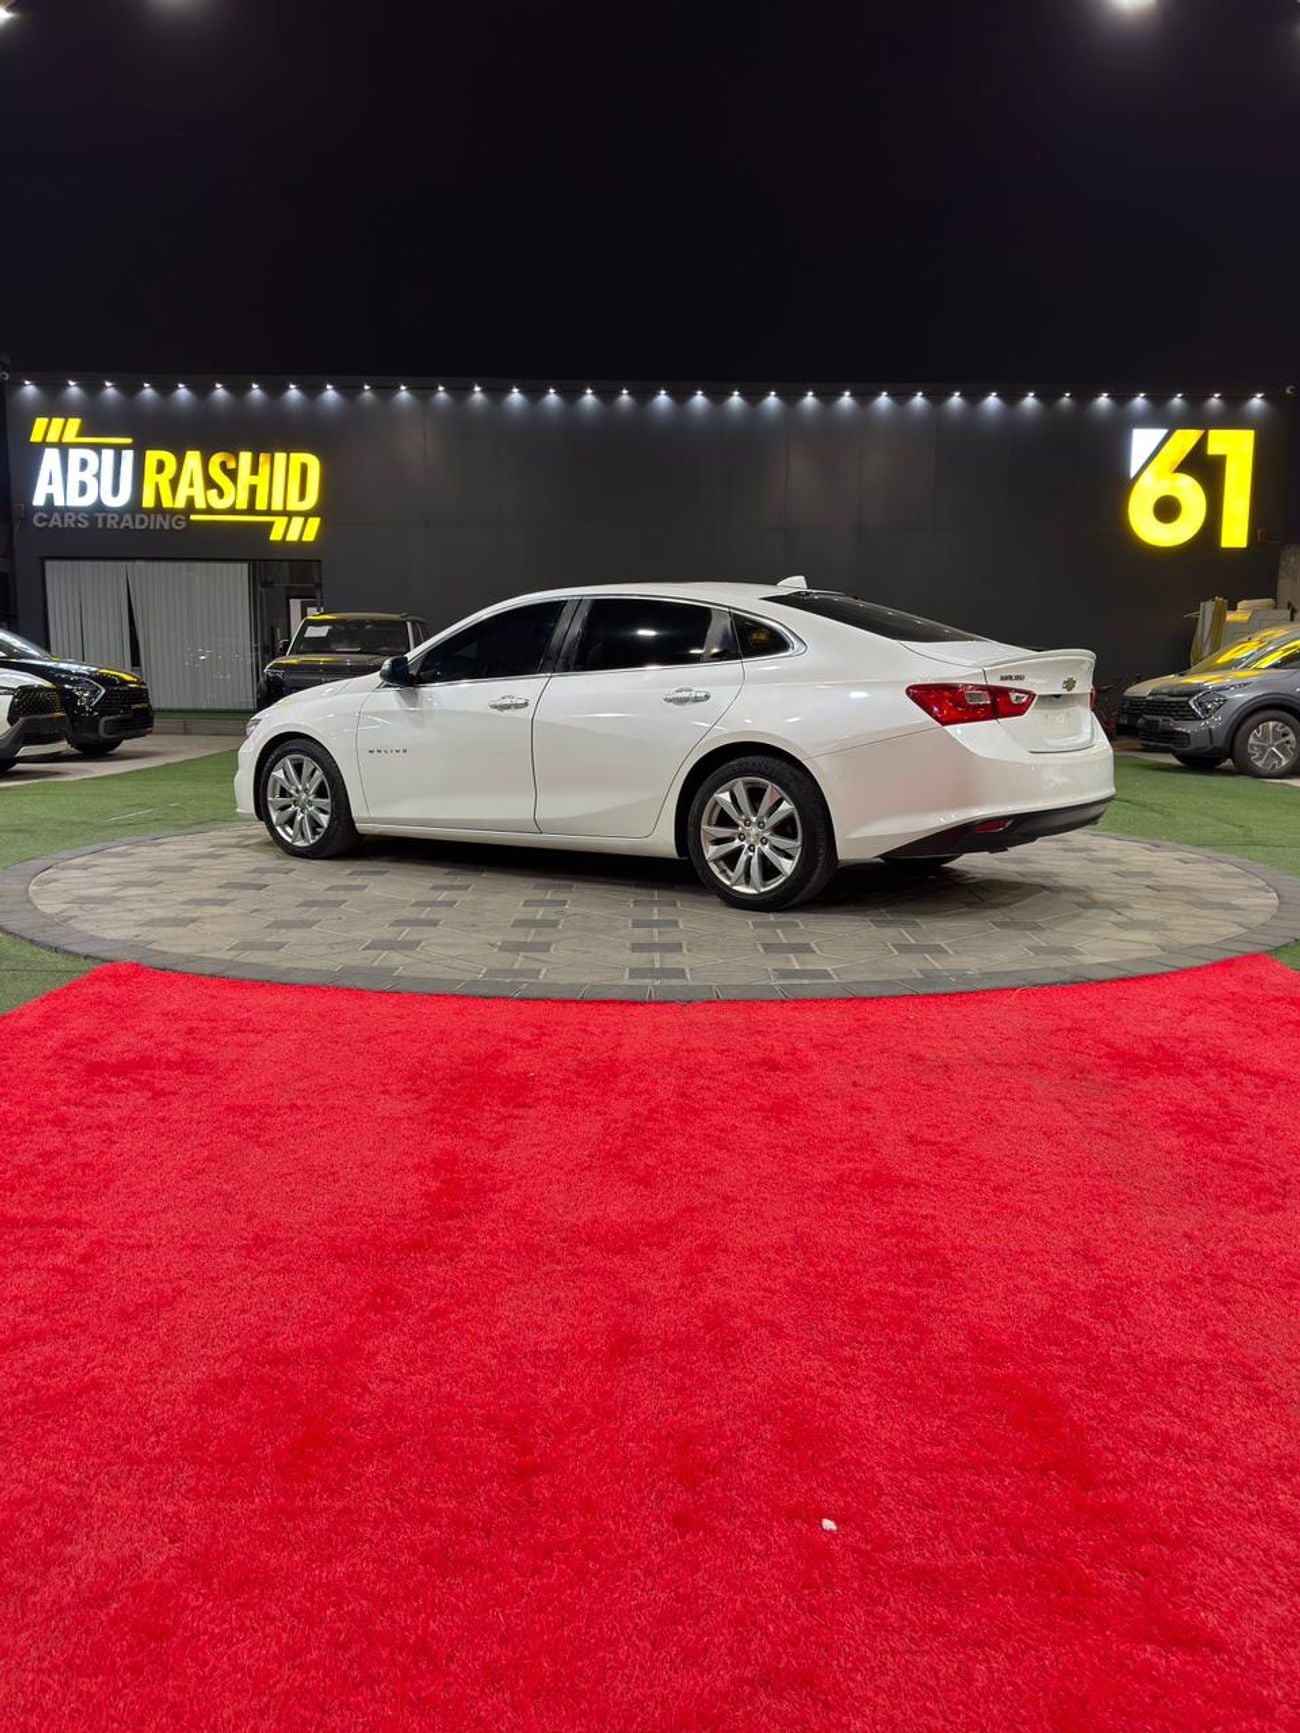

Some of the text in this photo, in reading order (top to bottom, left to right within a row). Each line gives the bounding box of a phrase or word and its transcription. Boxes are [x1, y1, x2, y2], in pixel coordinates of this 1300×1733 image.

[32, 448, 321, 511] ABU RASHID
[1128, 428, 1255, 548] 61
[32, 512, 187, 530] CARS TRADING
